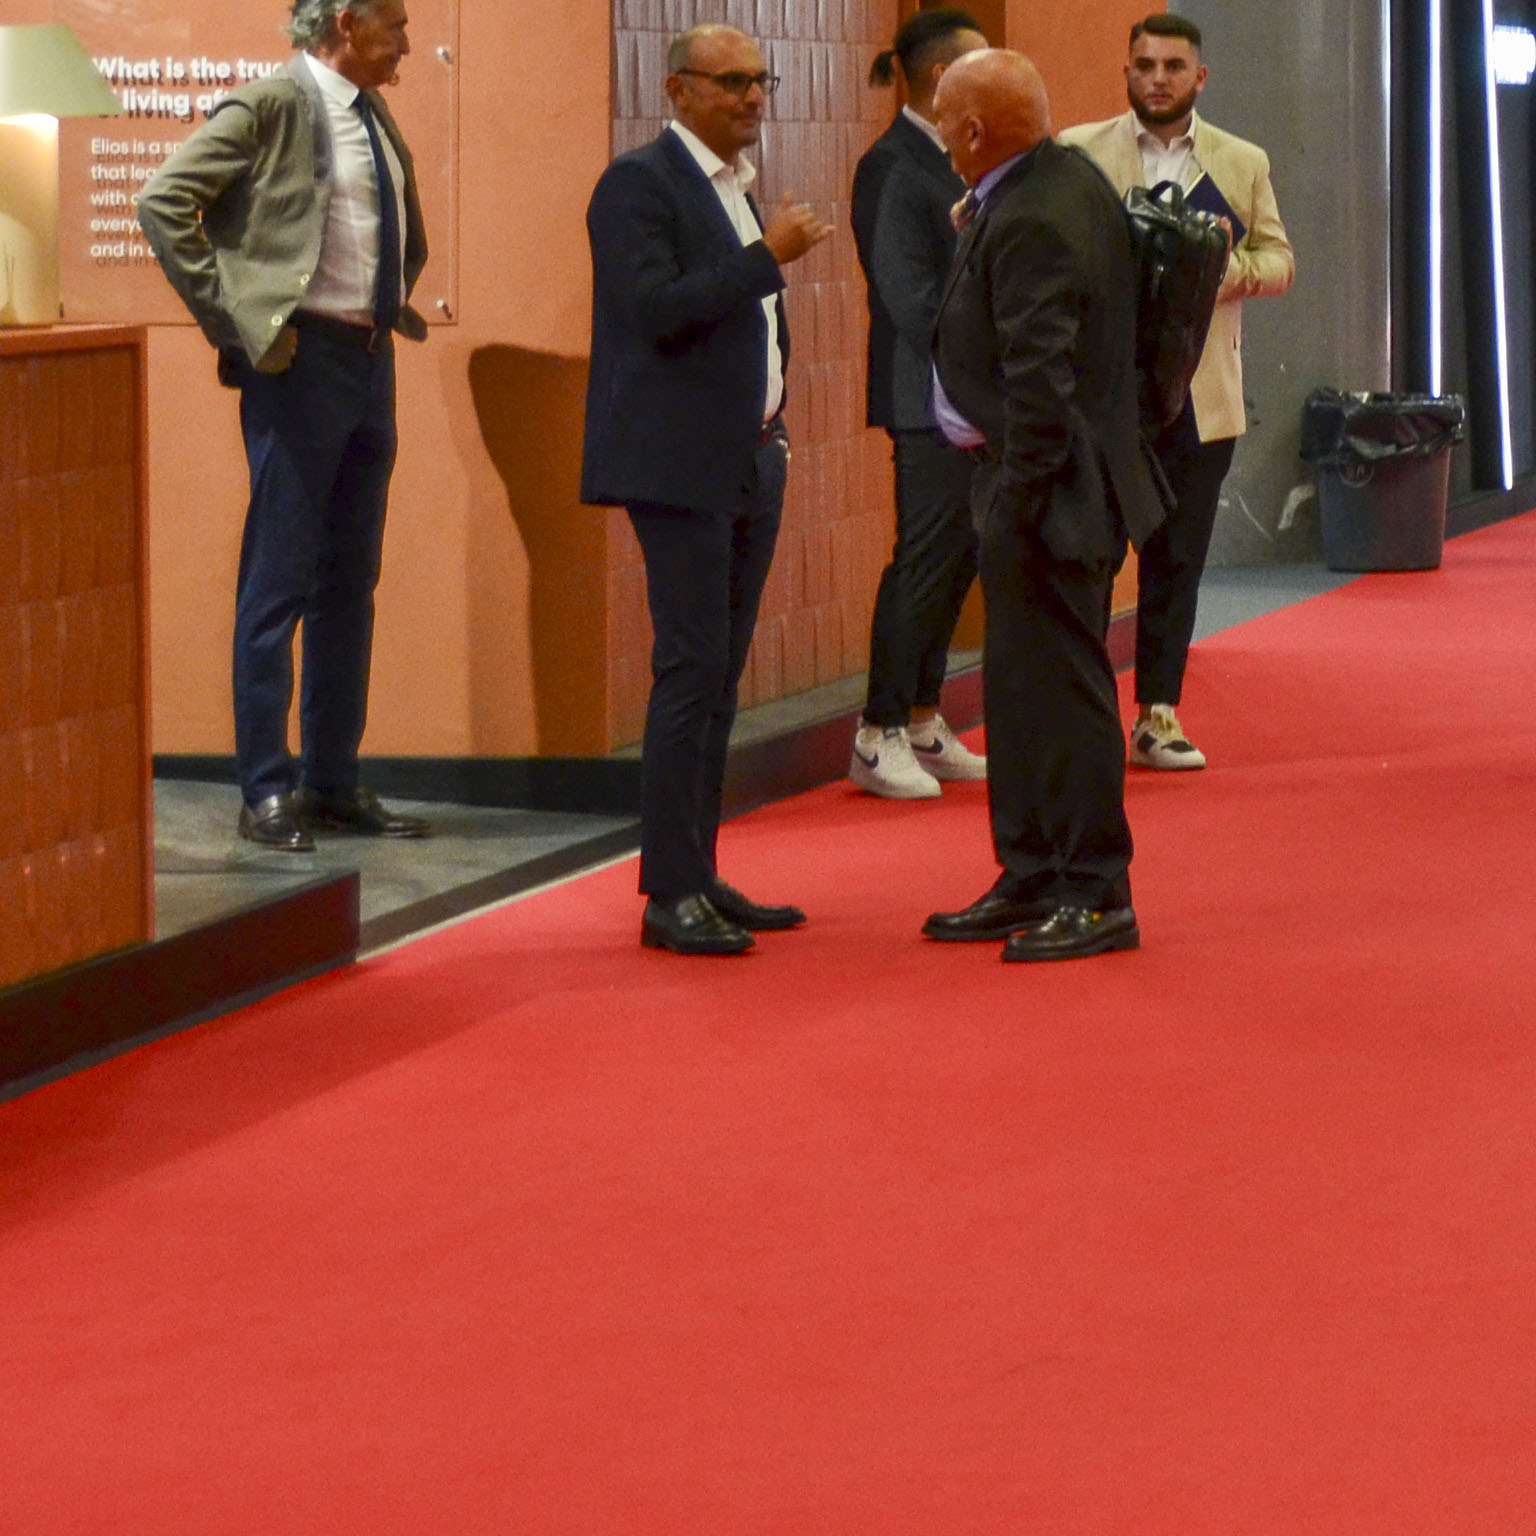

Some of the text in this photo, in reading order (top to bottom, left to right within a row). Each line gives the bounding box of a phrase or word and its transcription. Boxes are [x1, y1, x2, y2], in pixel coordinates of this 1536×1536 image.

[93, 56, 160, 78] What
[166, 56, 185, 78] is
[190, 56, 231, 78] the
[122, 88, 190, 116] living
[91, 138, 129, 155] Elios
[133, 138, 146, 155] is
[149, 142, 160, 155] a
[91, 164, 157, 181] that lea
[90, 189, 126, 206] with
[90, 219, 143, 235] every
[90, 241, 125, 257] and
[129, 241, 144, 257] in
